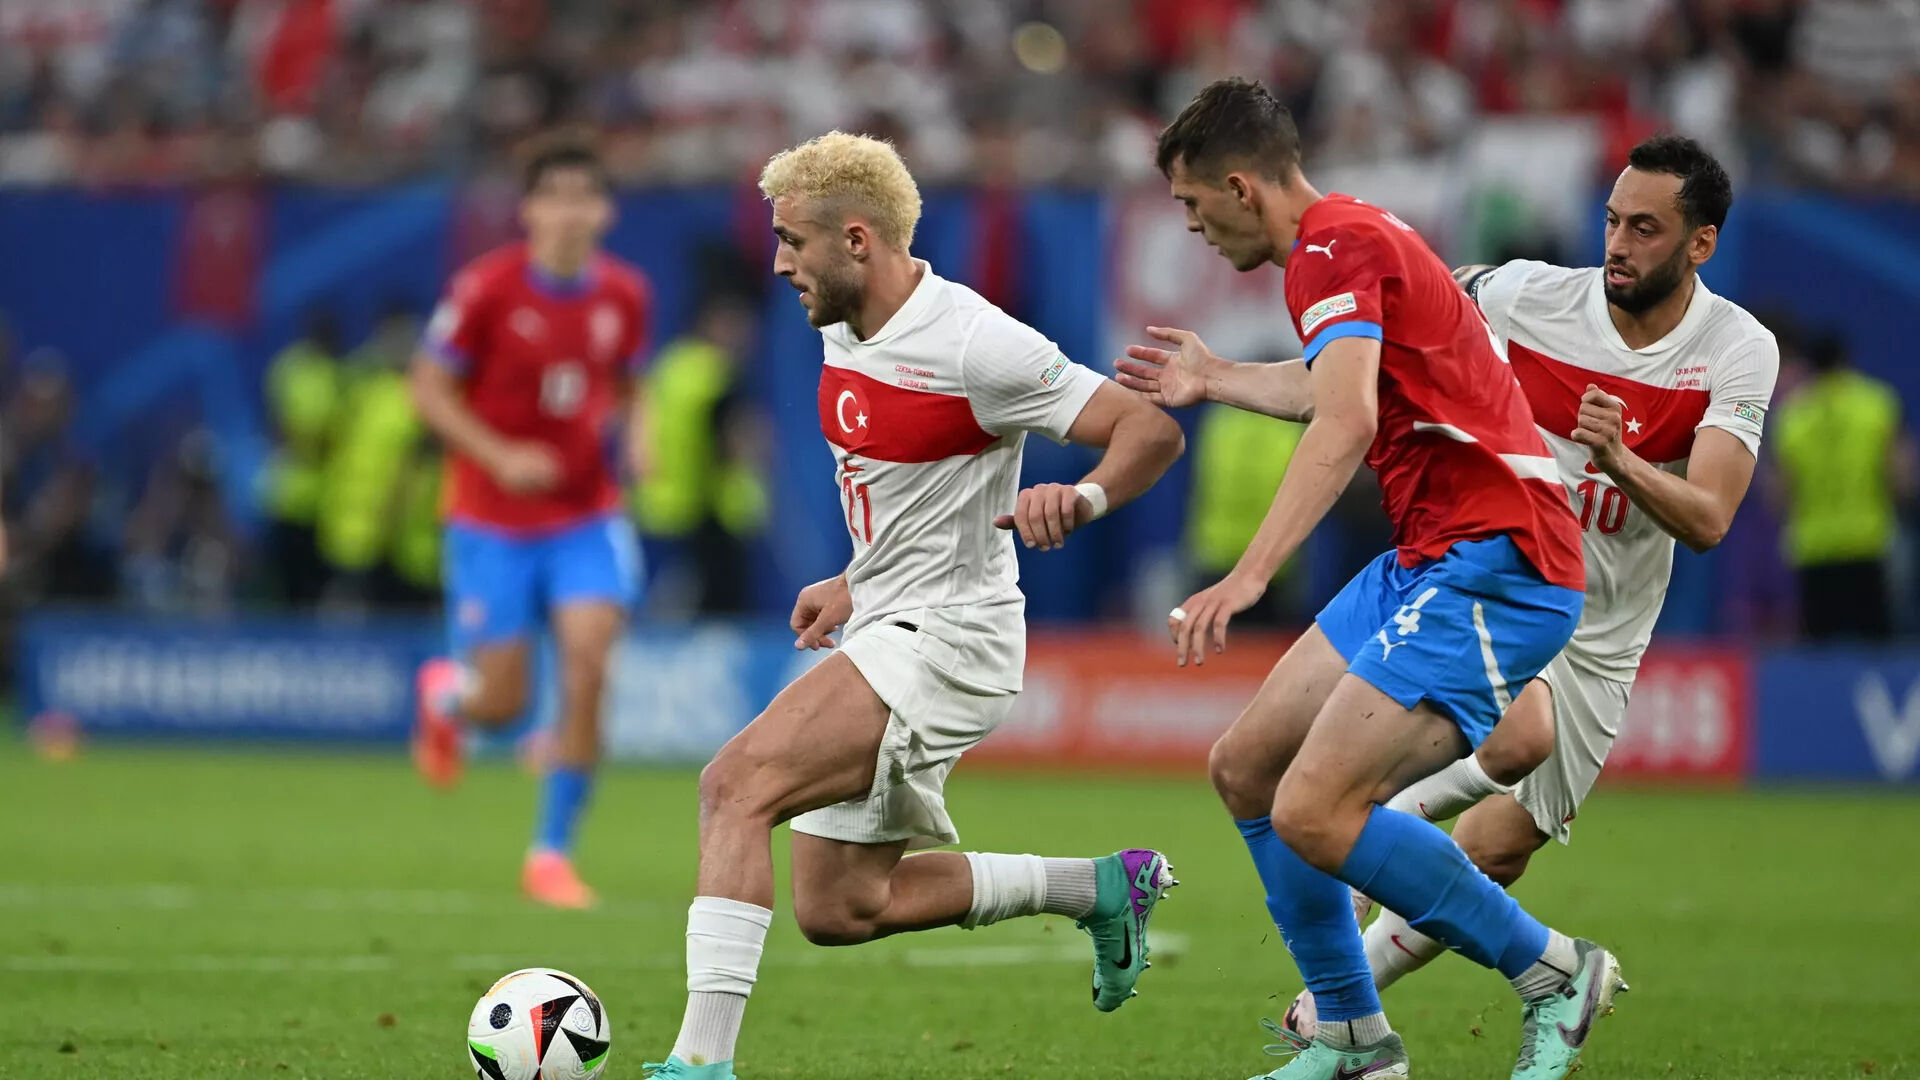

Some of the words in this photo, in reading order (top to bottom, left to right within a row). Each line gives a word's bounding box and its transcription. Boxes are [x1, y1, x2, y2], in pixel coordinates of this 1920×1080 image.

[842, 476, 873, 547] 21
[1577, 479, 1631, 536] 10
[1393, 587, 1439, 636] 4
